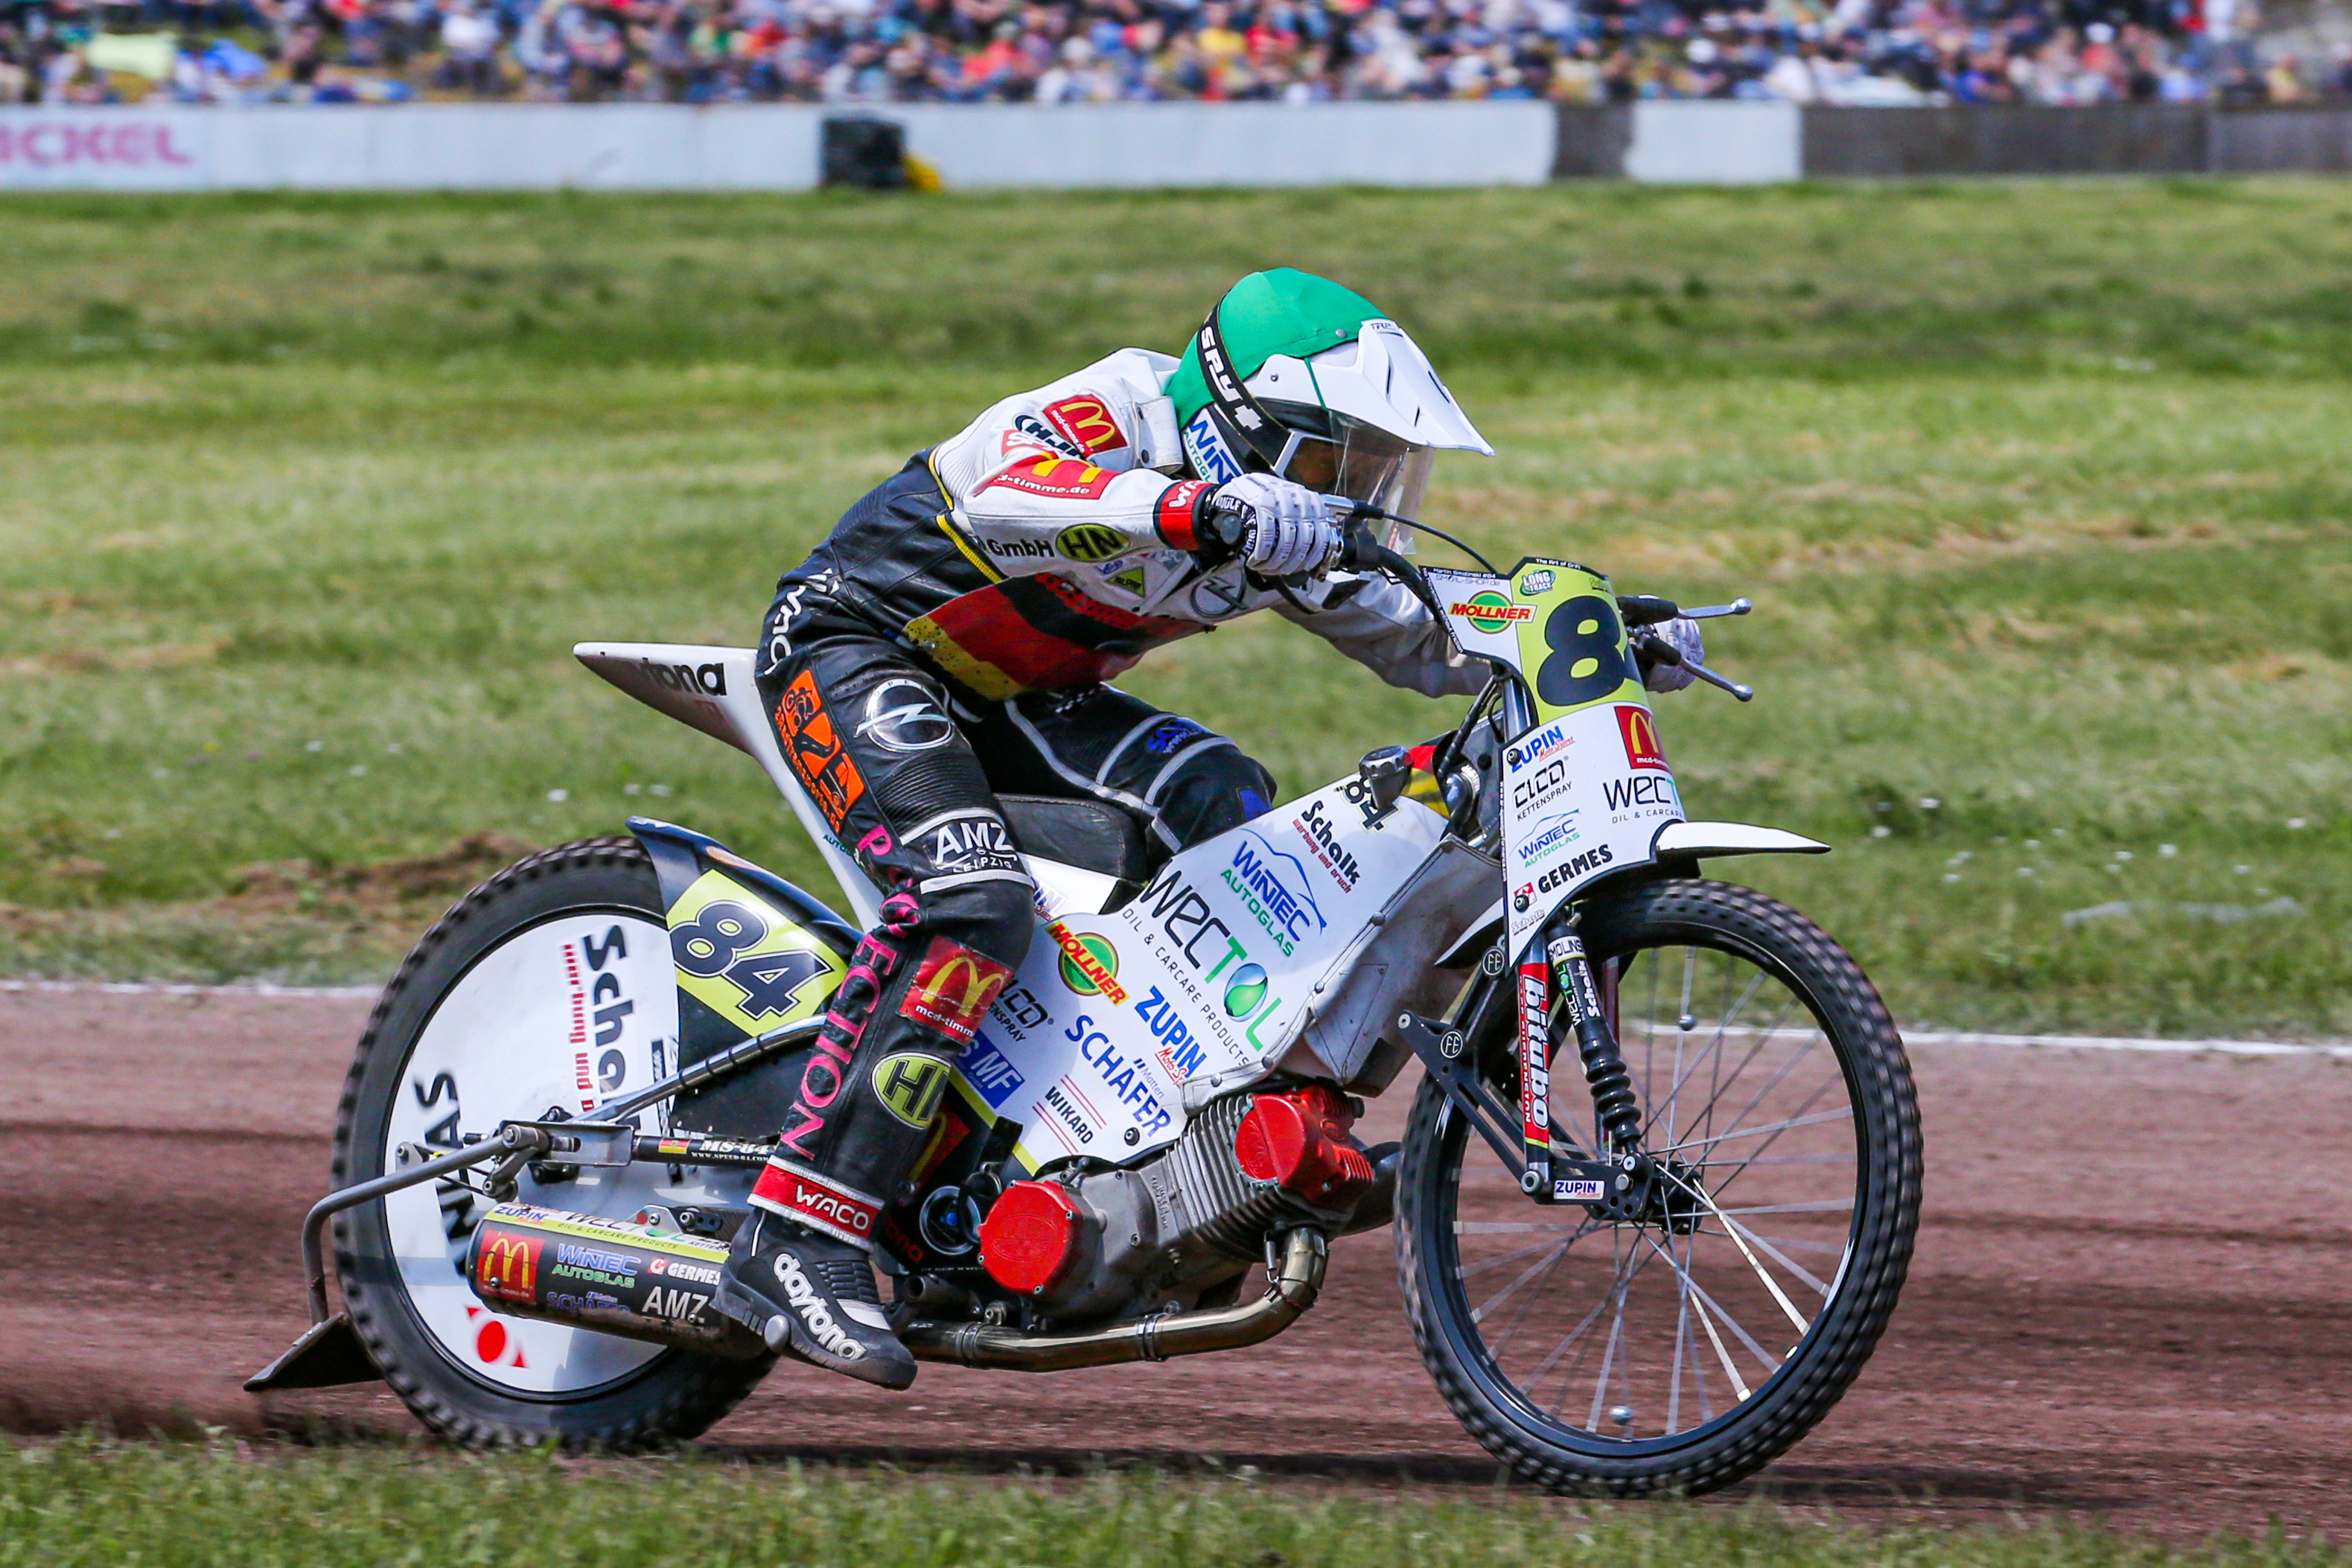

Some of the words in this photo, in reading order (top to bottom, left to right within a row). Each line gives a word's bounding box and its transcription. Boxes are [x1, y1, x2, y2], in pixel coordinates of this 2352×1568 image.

[986, 539, 1055, 558] GmbH
[1060, 528, 1119, 558] HN
[1522, 571, 1551, 587] LONG
[1529, 581, 1552, 593] TRACK
[1537, 596, 1628, 707] 8
[1517, 781, 1572, 821] KETTENSPRAY
[1612, 815, 1628, 823] OIL
[936, 822, 1013, 865] AMZ
[1301, 800, 1360, 885] Schalk
[1524, 832, 1580, 869] AUTOGLAS
[1538, 844, 1613, 893] GERMES
[1220, 869, 1294, 957] AUTOGLAS
[669, 901, 835, 1020] 84
[1121, 908, 1140, 931] OIL
[1144, 933, 1155, 946] &
[1156, 947, 1202, 1004] CARCARE
[1200, 1004, 1250, 1067] PRODUCTS
[583, 925, 634, 1108] Scha
[1134, 986, 1207, 1078] ZUPIN
[1523, 975, 1549, 1129] bitubo
[1065, 1014, 1171, 1138] SCHÄFER
[1141, 1068, 1164, 1099] Matten
[1045, 1086, 1094, 1145] WIKARD
[796, 1184, 869, 1230] WACO
[1555, 1182, 1596, 1193] ZUPIN
[494, 1205, 546, 1221] ZUPIN
[552, 1264, 635, 1289] AUTOGLAS
[774, 1253, 868, 1360] daytona
